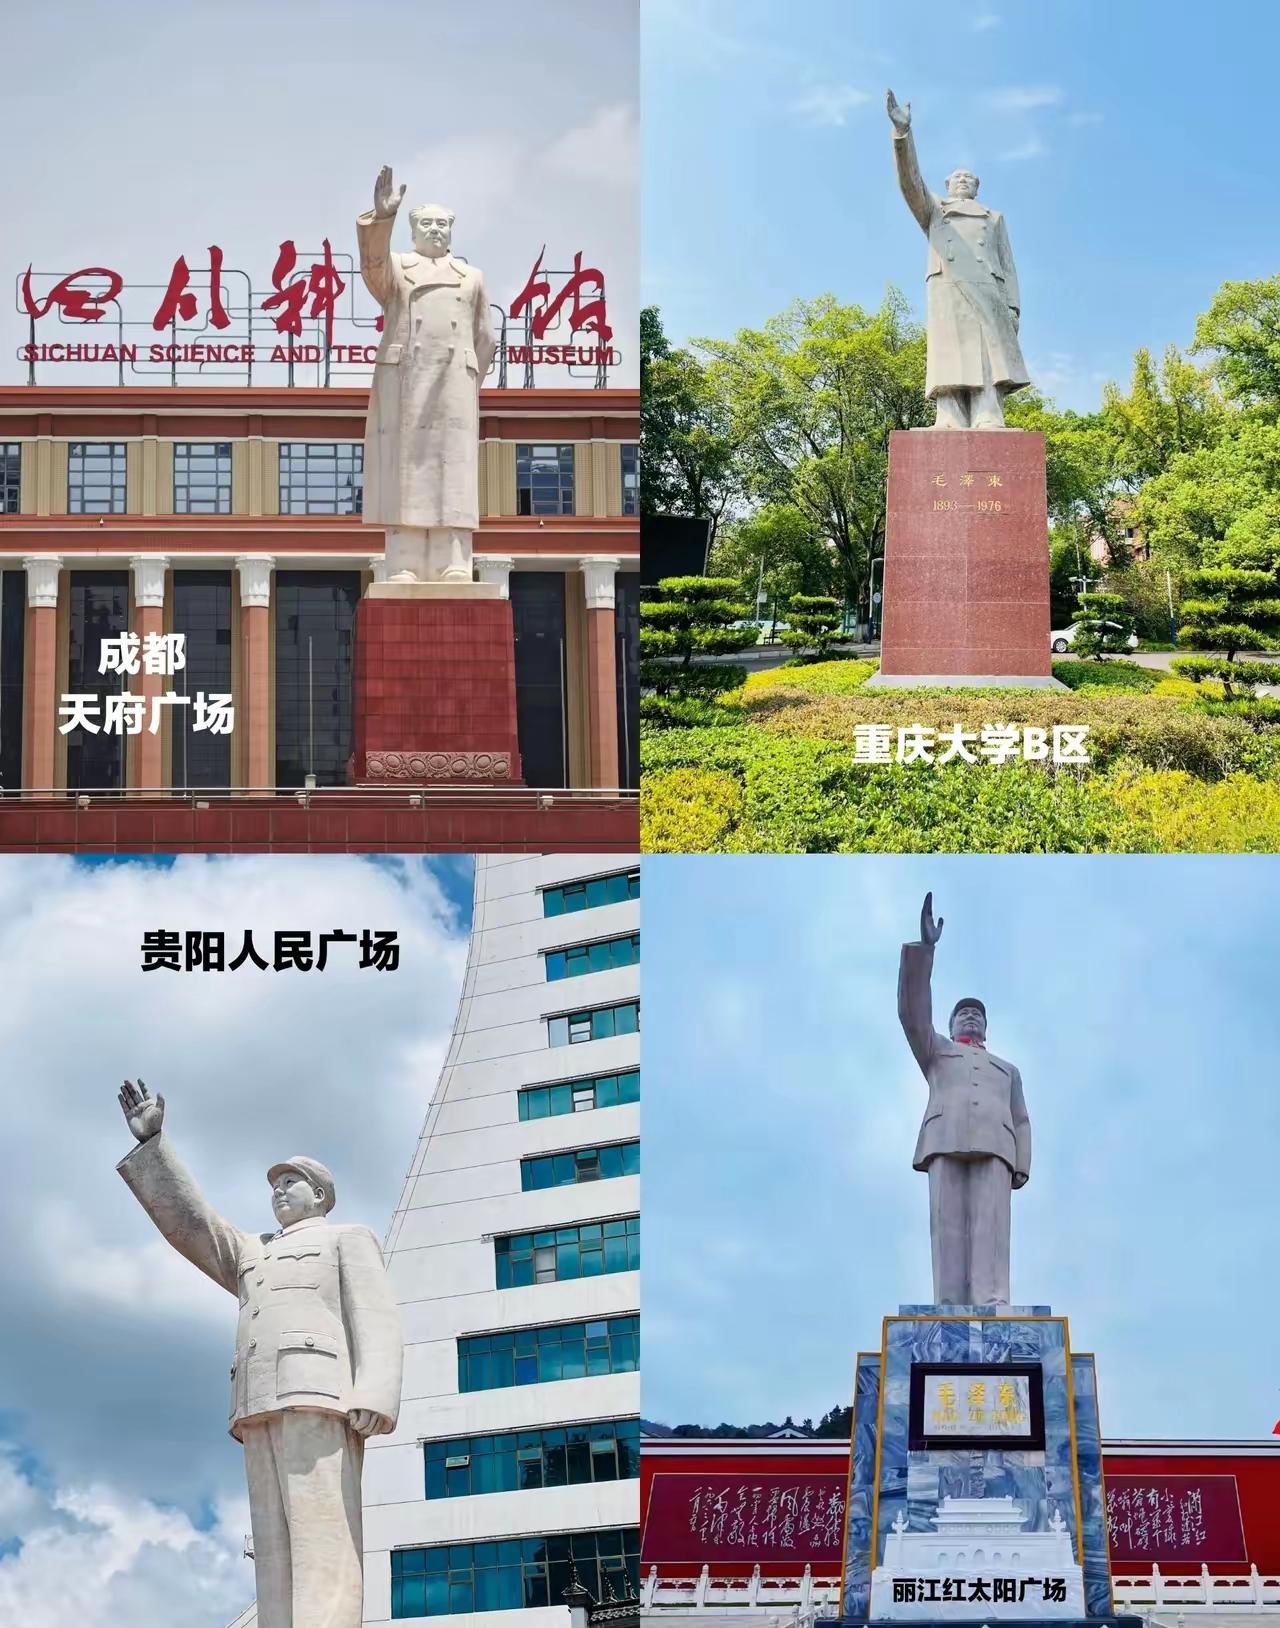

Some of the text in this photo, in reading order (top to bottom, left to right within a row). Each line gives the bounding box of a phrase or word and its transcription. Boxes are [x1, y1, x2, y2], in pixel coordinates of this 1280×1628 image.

[22, 237, 613, 347] 四川科馆
[24, 344, 137, 363] SICHUAN
[149, 345, 256, 363] SCIENCE
[270, 345, 321, 363] AND
[508, 346, 614, 364] MUSEUM
